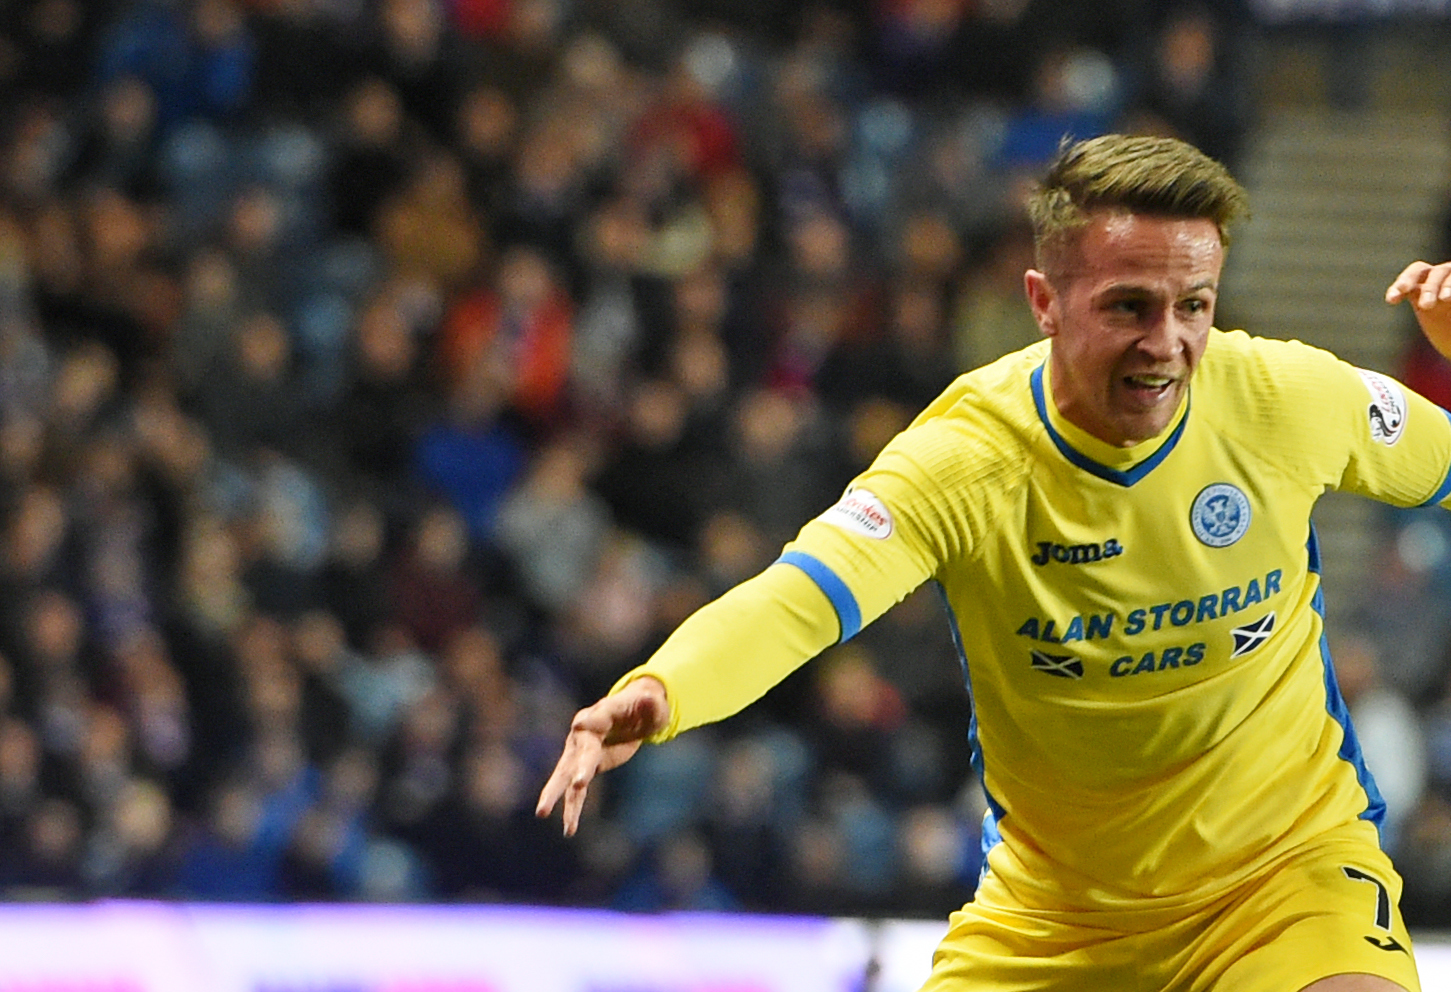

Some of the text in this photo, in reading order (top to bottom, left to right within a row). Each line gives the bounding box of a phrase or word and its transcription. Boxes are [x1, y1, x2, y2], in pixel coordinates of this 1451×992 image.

[1030, 538, 1123, 566] Joma
[1016, 569, 1282, 644] ALAN STORRAR
[1109, 642, 1206, 677] CARS
[1341, 866, 1390, 932] 7
